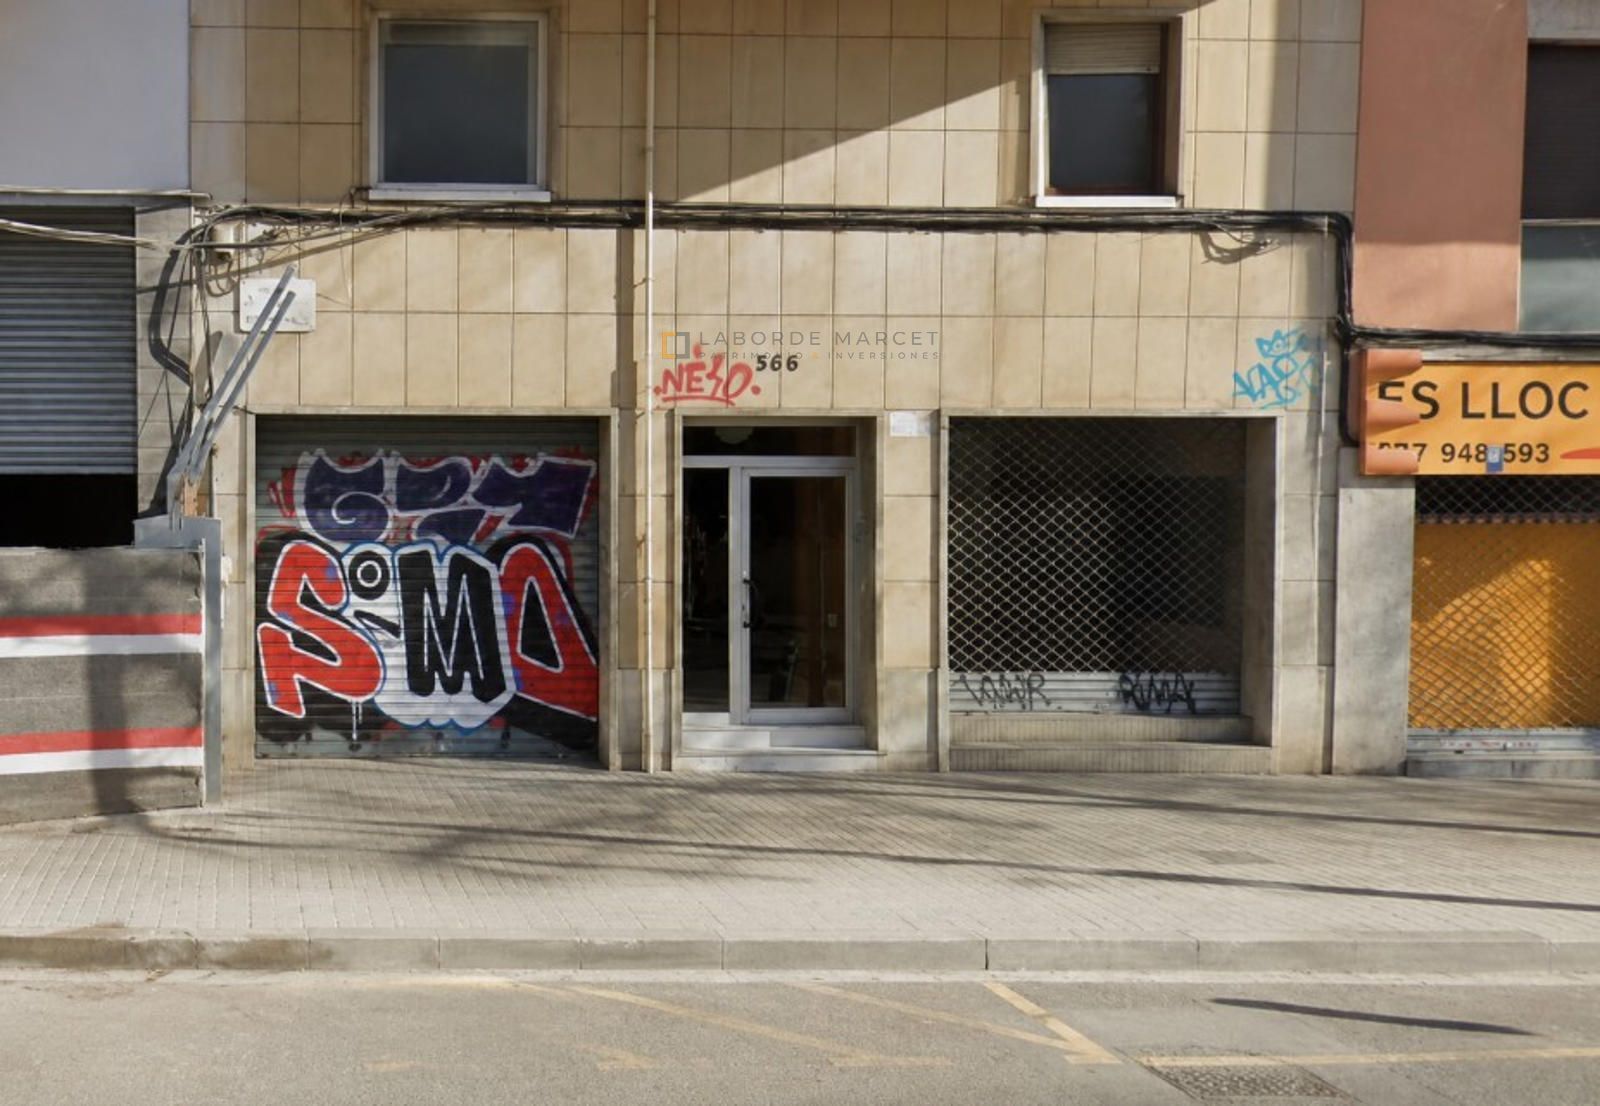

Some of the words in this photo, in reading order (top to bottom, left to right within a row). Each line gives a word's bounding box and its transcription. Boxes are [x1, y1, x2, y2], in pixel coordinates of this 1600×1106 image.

[755, 354, 799, 372] 566
[1461, 380, 1590, 420] LLOC
[1441, 442, 1487, 464] 948
[1503, 442, 1550, 464] 593
